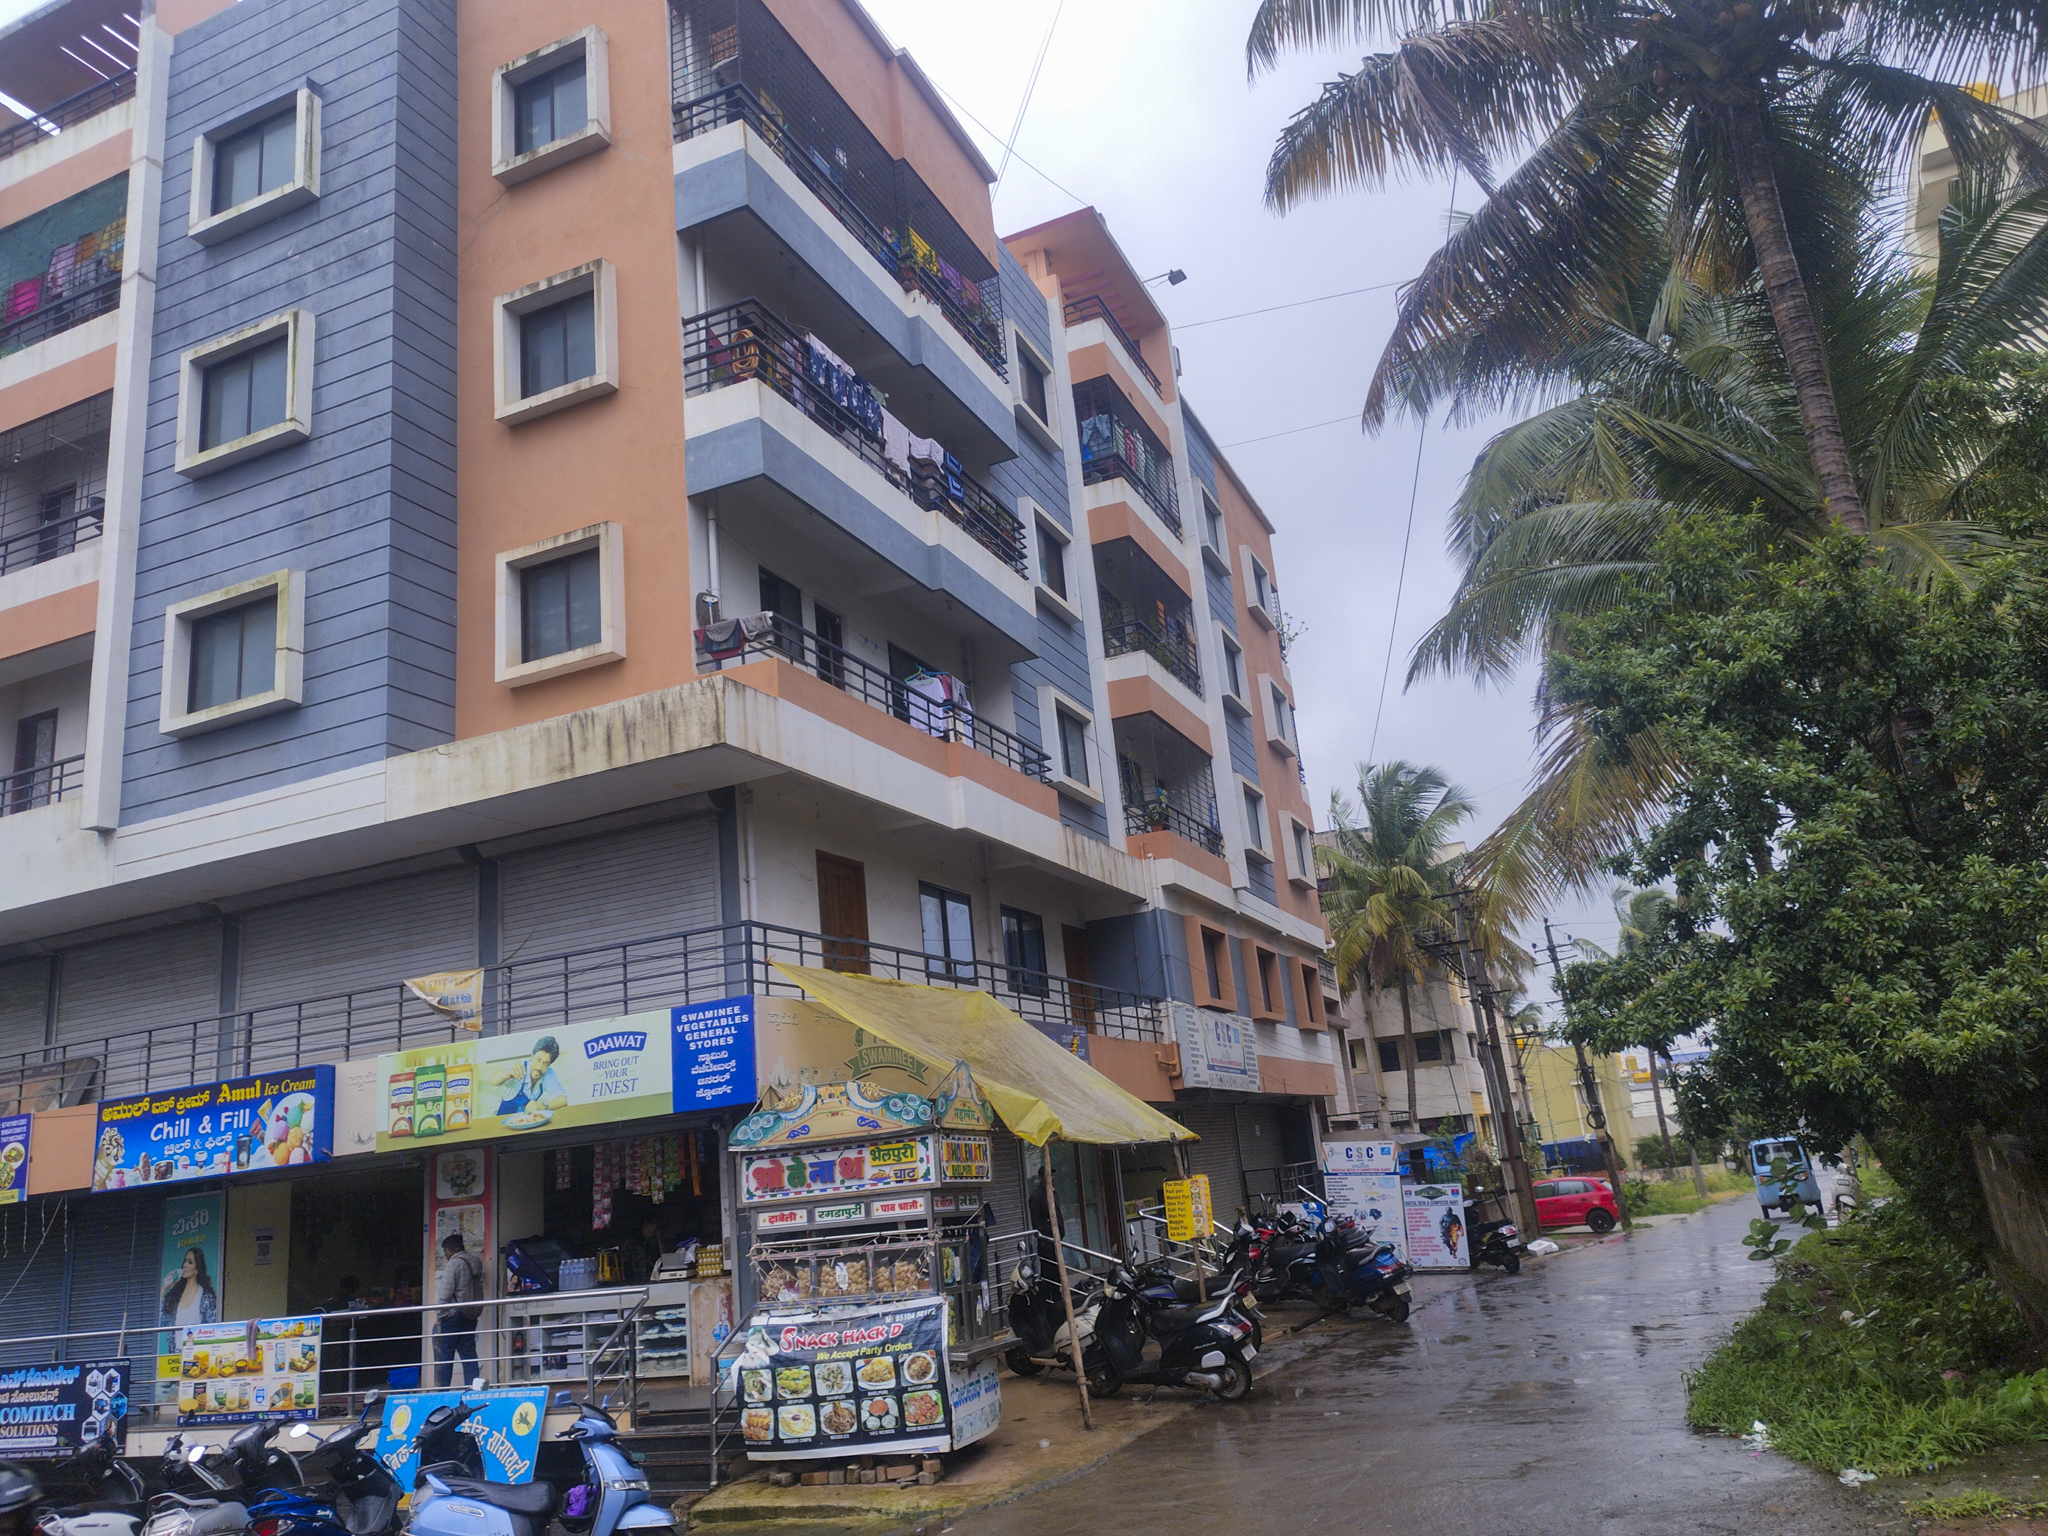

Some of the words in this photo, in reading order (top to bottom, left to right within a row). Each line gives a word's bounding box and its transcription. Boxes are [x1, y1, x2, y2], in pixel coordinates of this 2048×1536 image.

[676, 1014, 749, 1033] VEGETABLES
[681, 1006, 741, 1023] SWAMINEE
[685, 1026, 738, 1041] GENERAL
[689, 1036, 734, 1050] STORES
[586, 1034, 645, 1055] DAAWAT
[593, 1058, 620, 1071] BRING
[621, 1056, 639, 1066] OUT
[862, 1050, 914, 1069] SWAMINEE
[604, 1068, 628, 1079] YOUR
[592, 1077, 639, 1098] FINEST
[102, 1097, 150, 1122] ಅಮುಲ್
[151, 1096, 175, 1114] ಐಸ್
[176, 1090, 210, 1115] ಕ್ರೀಮ್
[217, 1079, 260, 1105] Amul
[265, 1082, 279, 1096] Ice
[281, 1078, 316, 1094] Cream
[151, 1118, 190, 1142] Chill
[200, 1115, 212, 1134] &
[221, 1108, 250, 1130] Fill
[193, 1138, 203, 1151] &
[869, 1144, 915, 1165] भेलपुरी
[893, 1167, 917, 1181] चाट
[818, 1204, 863, 1222] रगडापुरी
[780, 1326, 839, 1353] SNACK
[842, 1328, 887, 1346] HACK
[889, 1323, 903, 1338] D
[816, 1352, 830, 1361] We
[830, 1349, 859, 1360] Accept
[860, 1345, 883, 1357] Party
[884, 1342, 913, 1354] Orders
[0, 1403, 76, 1425] COMTECH
[0, 1423, 58, 1438] SOLUTIONS
